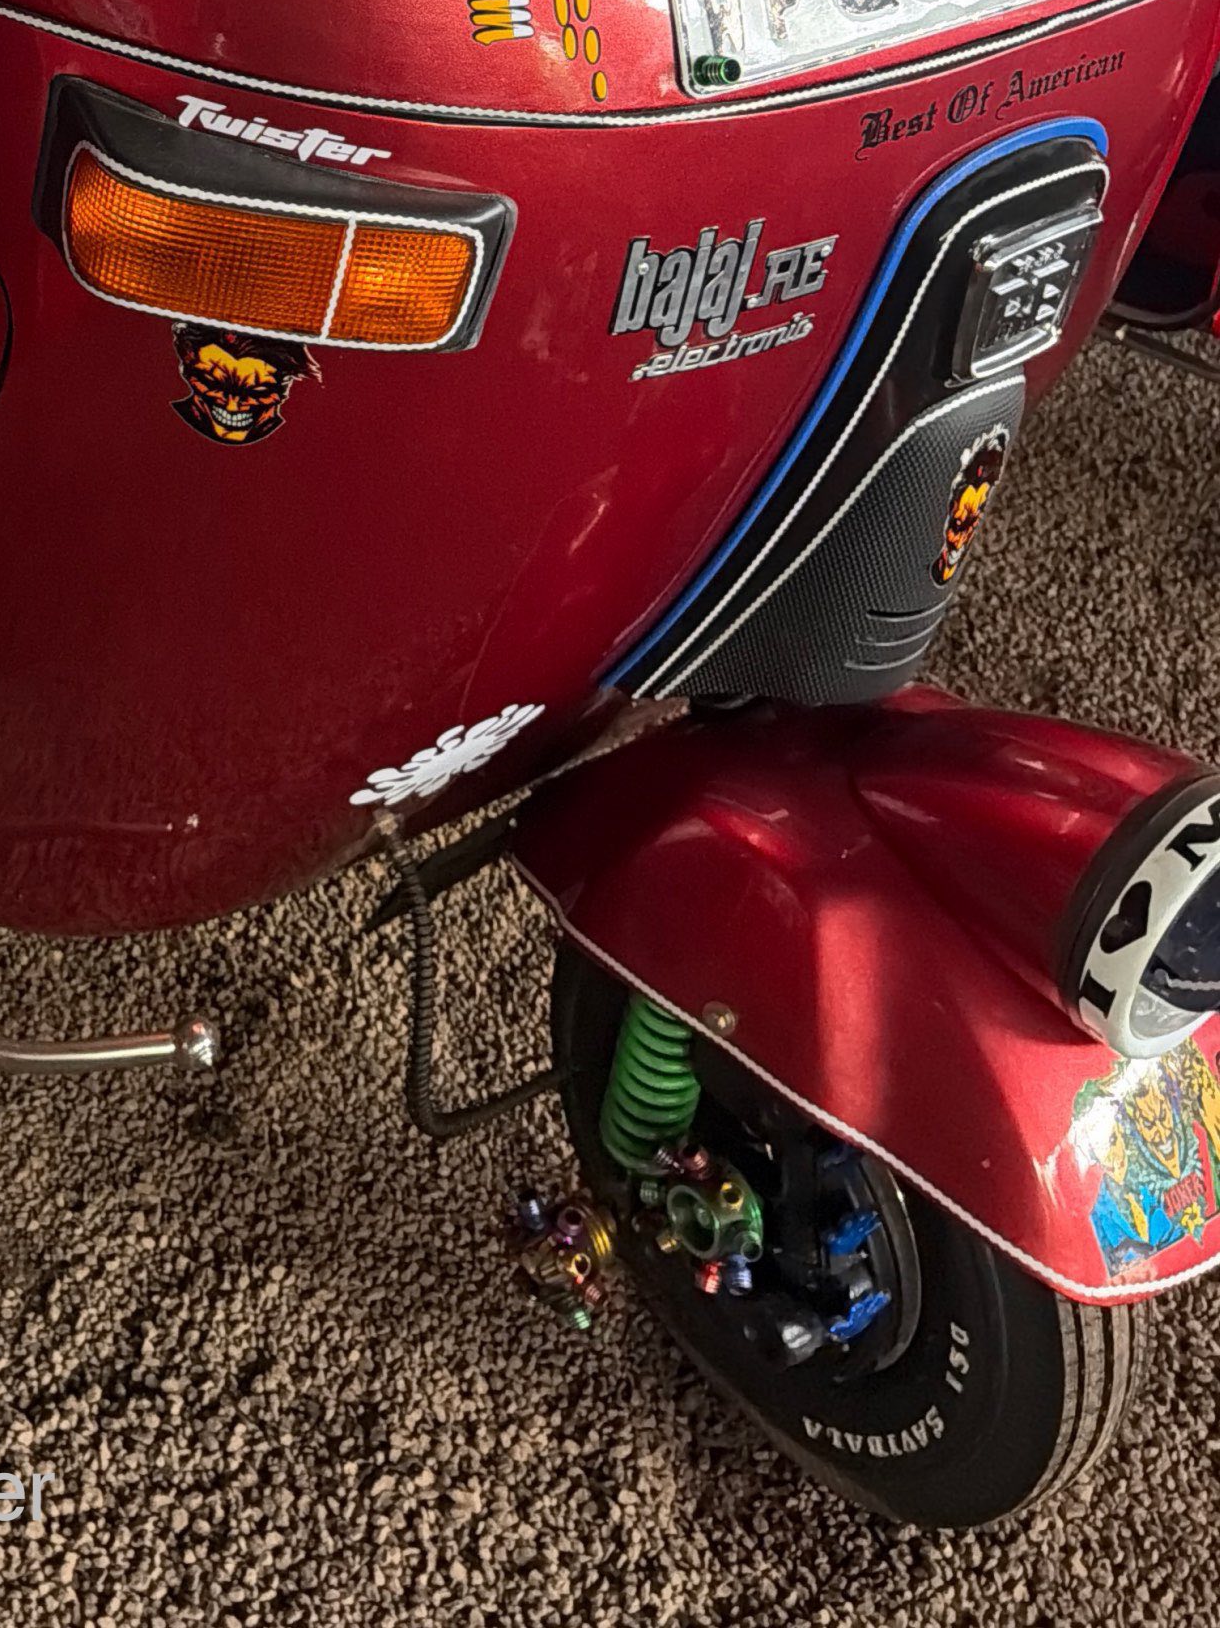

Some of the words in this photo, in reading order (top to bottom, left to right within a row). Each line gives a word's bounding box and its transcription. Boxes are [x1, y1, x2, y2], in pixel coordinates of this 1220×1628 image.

[176, 94, 392, 165] Twister
[854, 100, 938, 161] Best
[946, 81, 995, 124] Of
[994, 51, 1126, 121] American
[609, 217, 766, 347] bajaj
[632, 312, 816, 380] electronic
[1080, 969, 1117, 1020] I
[945, 1322, 970, 1394] DSI
